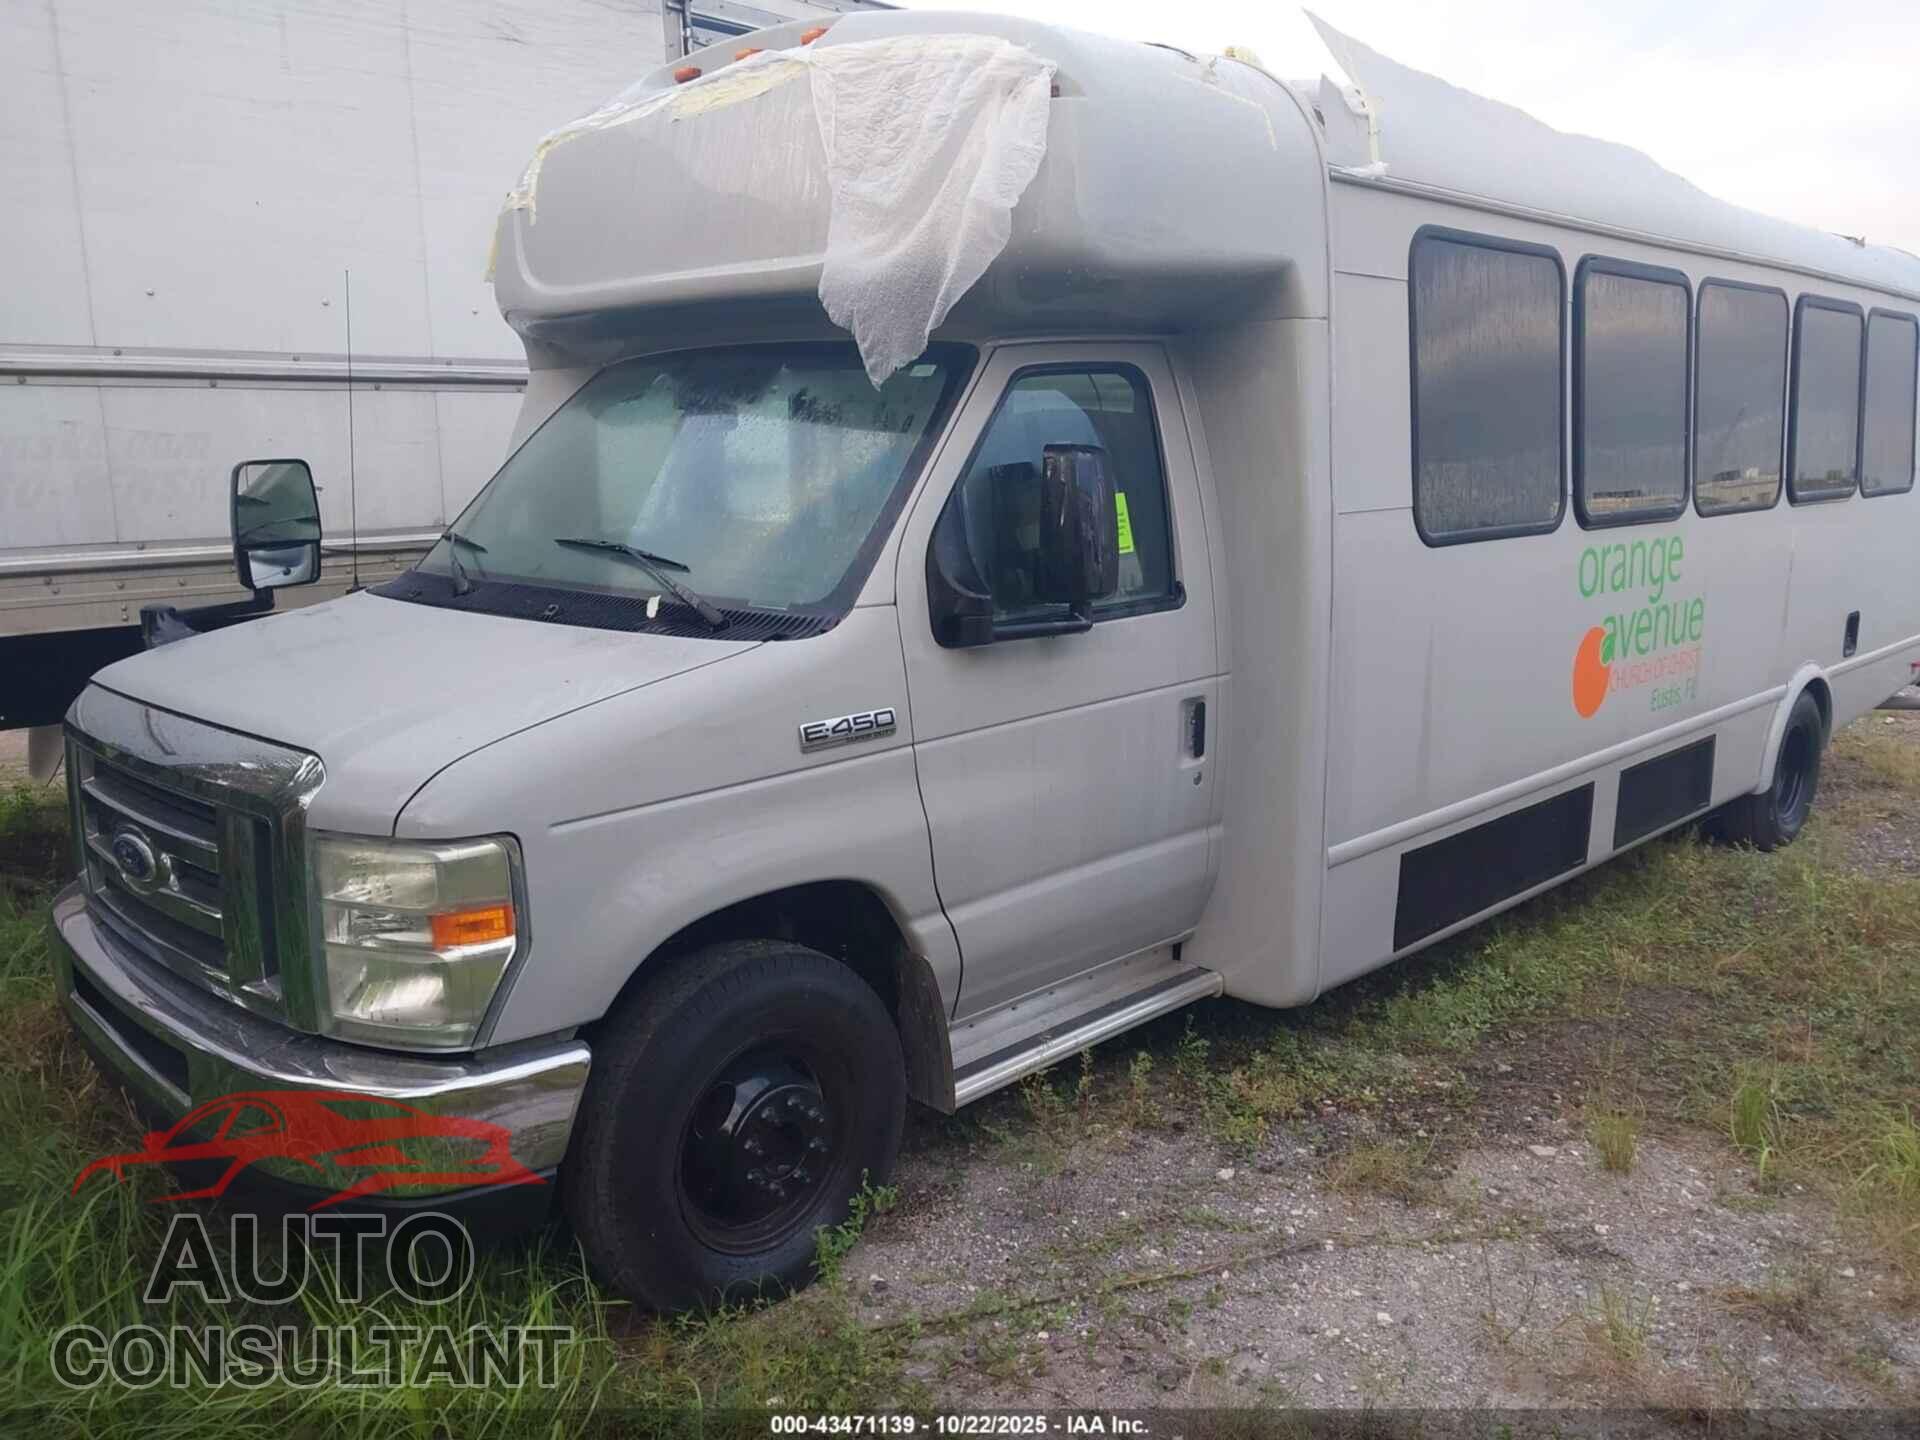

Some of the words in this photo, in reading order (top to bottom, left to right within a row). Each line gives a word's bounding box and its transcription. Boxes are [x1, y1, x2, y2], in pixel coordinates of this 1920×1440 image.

[1578, 535, 1685, 604] orange
[1601, 597, 1705, 666] avenue
[801, 708, 896, 742] E-450
